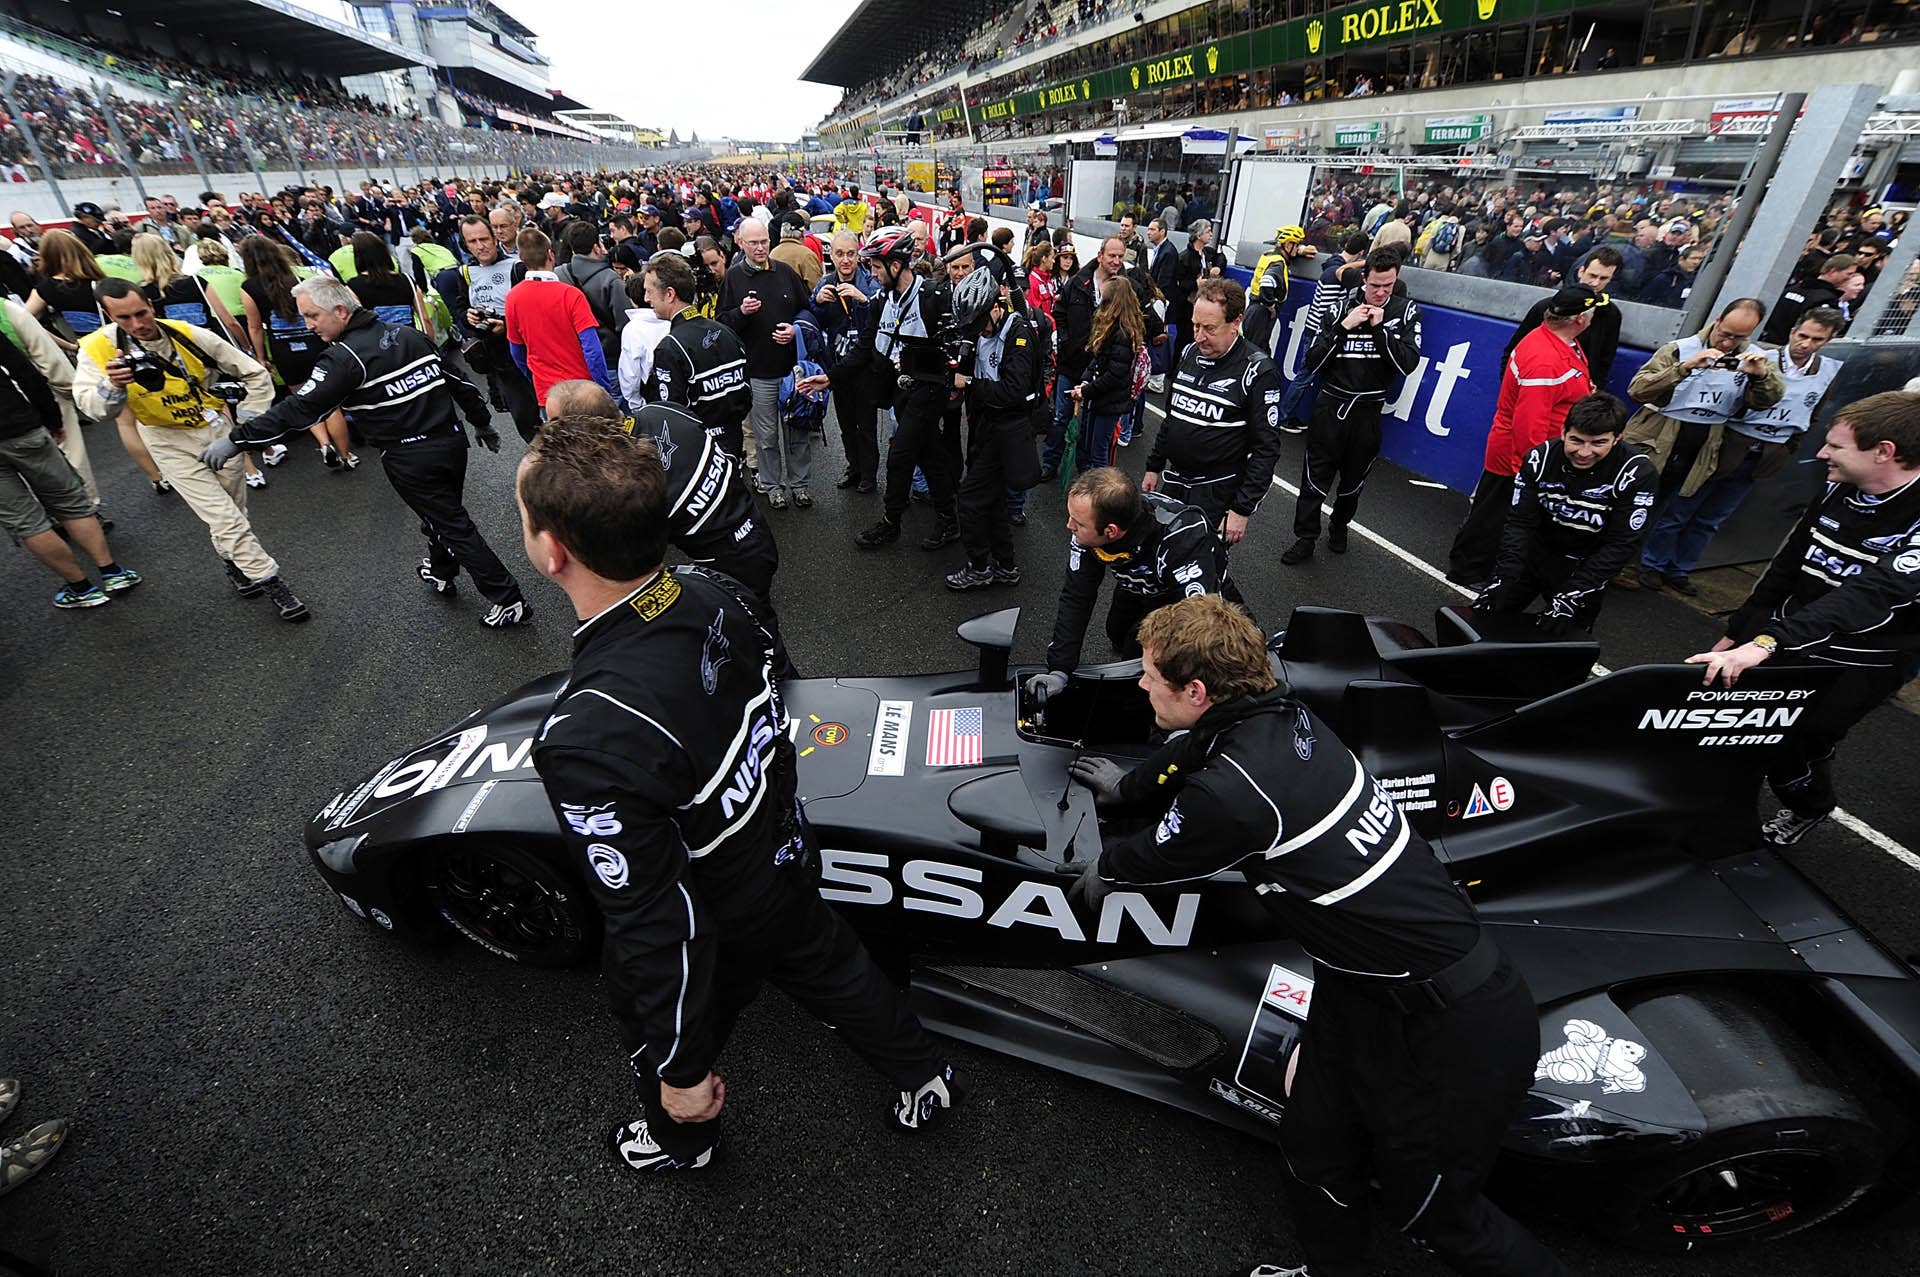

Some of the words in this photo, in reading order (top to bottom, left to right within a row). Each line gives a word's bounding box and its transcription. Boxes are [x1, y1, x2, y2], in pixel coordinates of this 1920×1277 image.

[1341, 0, 1442, 43] ROLEX
[1147, 54, 1193, 84] ROLEX
[1050, 85, 1077, 104] ROLEX
[988, 103, 1007, 116] ROLEX
[1340, 132, 1372, 144] FERRARI
[1431, 128, 1472, 140] FERRARI
[161, 390, 198, 407] NIKO
[1699, 391, 1723, 404] T.V.
[1765, 407, 1791, 422] T.V.
[1804, 544, 1863, 577] ISSA
[1686, 690, 1785, 702] POWERED
[1786, 689, 1816, 700] BY
[886, 705, 903, 718] LE
[1638, 706, 1804, 730] NISSAN
[825, 726, 838, 744] TOW
[879, 720, 899, 757] MANS
[1698, 734, 1784, 746] nismo
[1496, 783, 1509, 805] E
[564, 811, 623, 836] 56
[1272, 982, 1307, 1005] 24
